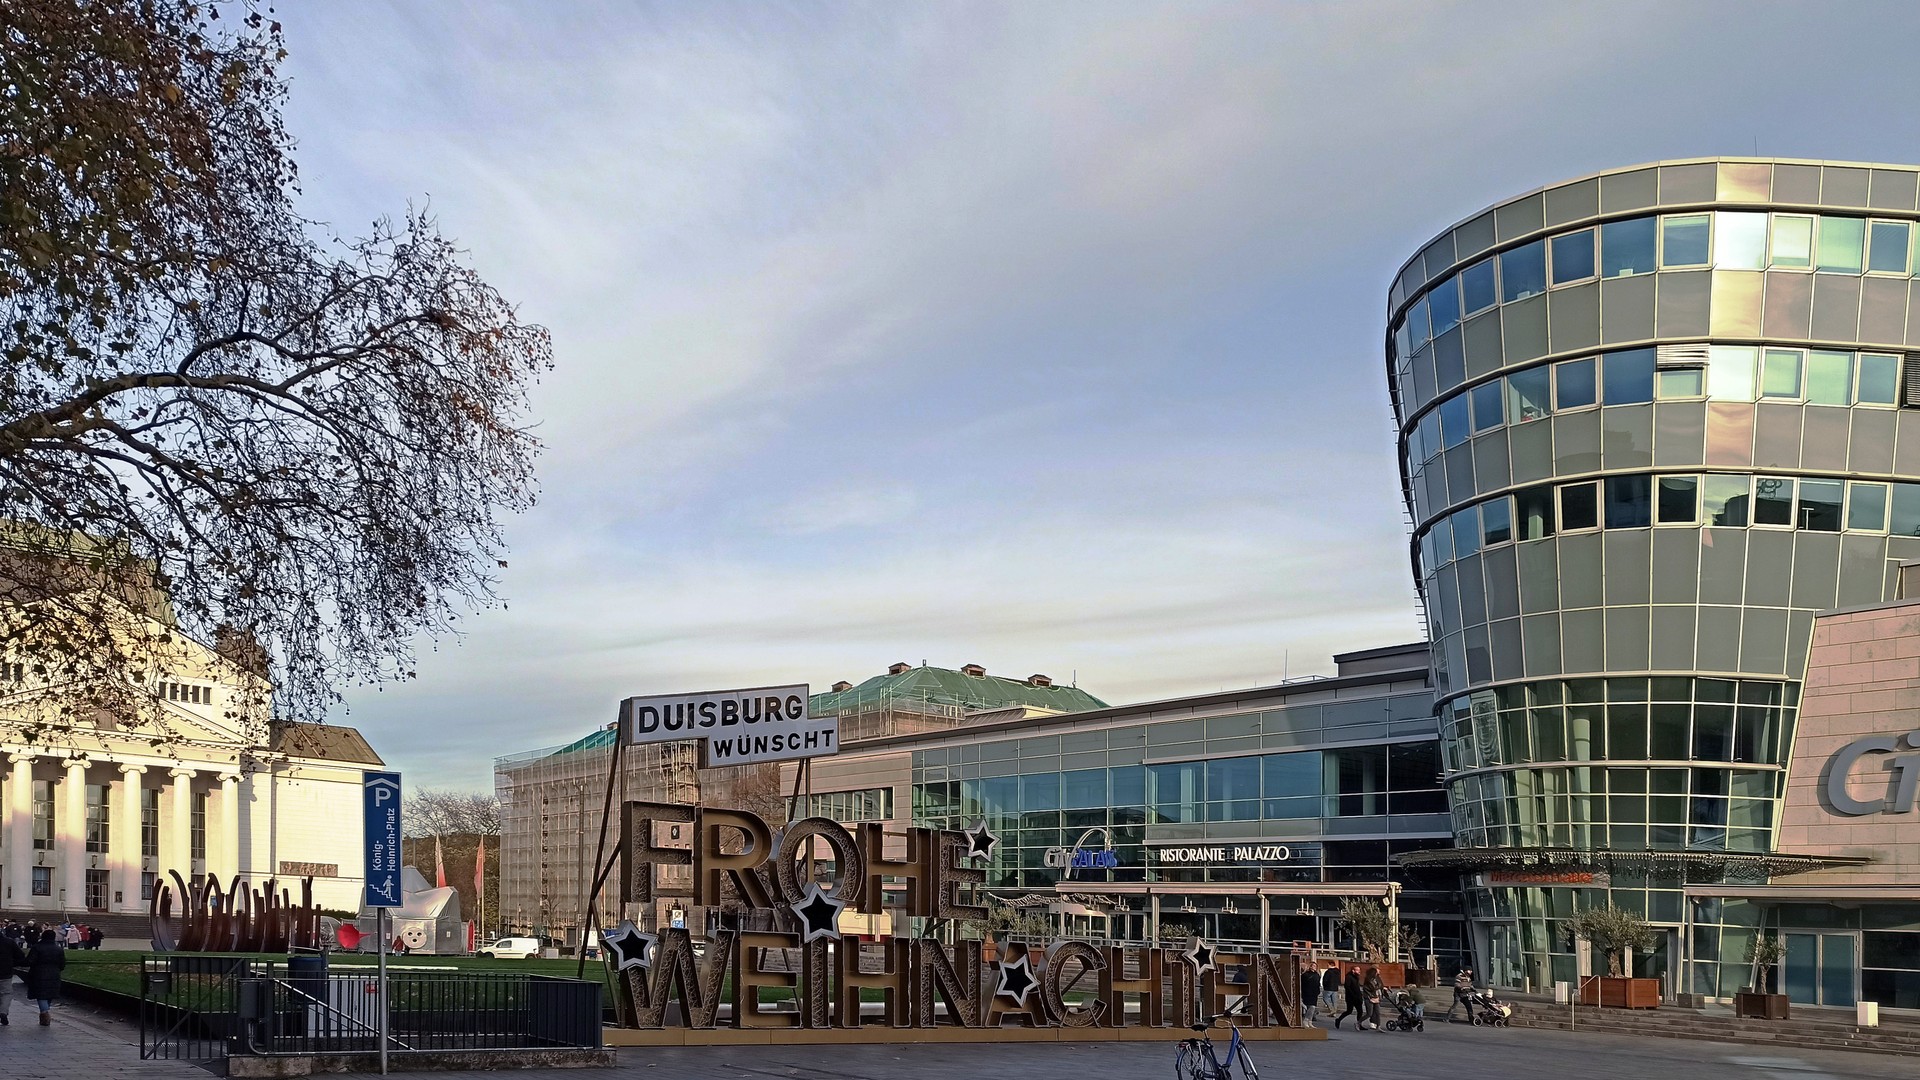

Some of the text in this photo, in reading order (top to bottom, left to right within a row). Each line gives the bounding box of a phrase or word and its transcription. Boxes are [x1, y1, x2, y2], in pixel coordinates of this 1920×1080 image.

[638, 695, 803, 734] DUISBURG
[713, 729, 835, 758] WÜNSCHT
[375, 787, 391, 807] P
[372, 841, 383, 870] König-
[386, 808, 395, 871] Heinrich-Platz
[1160, 846, 1290, 862] RISTORANTE PALAZZO
[620, 800, 990, 921] FROHE
[614, 926, 1302, 1029] WEIHNACHTEN
